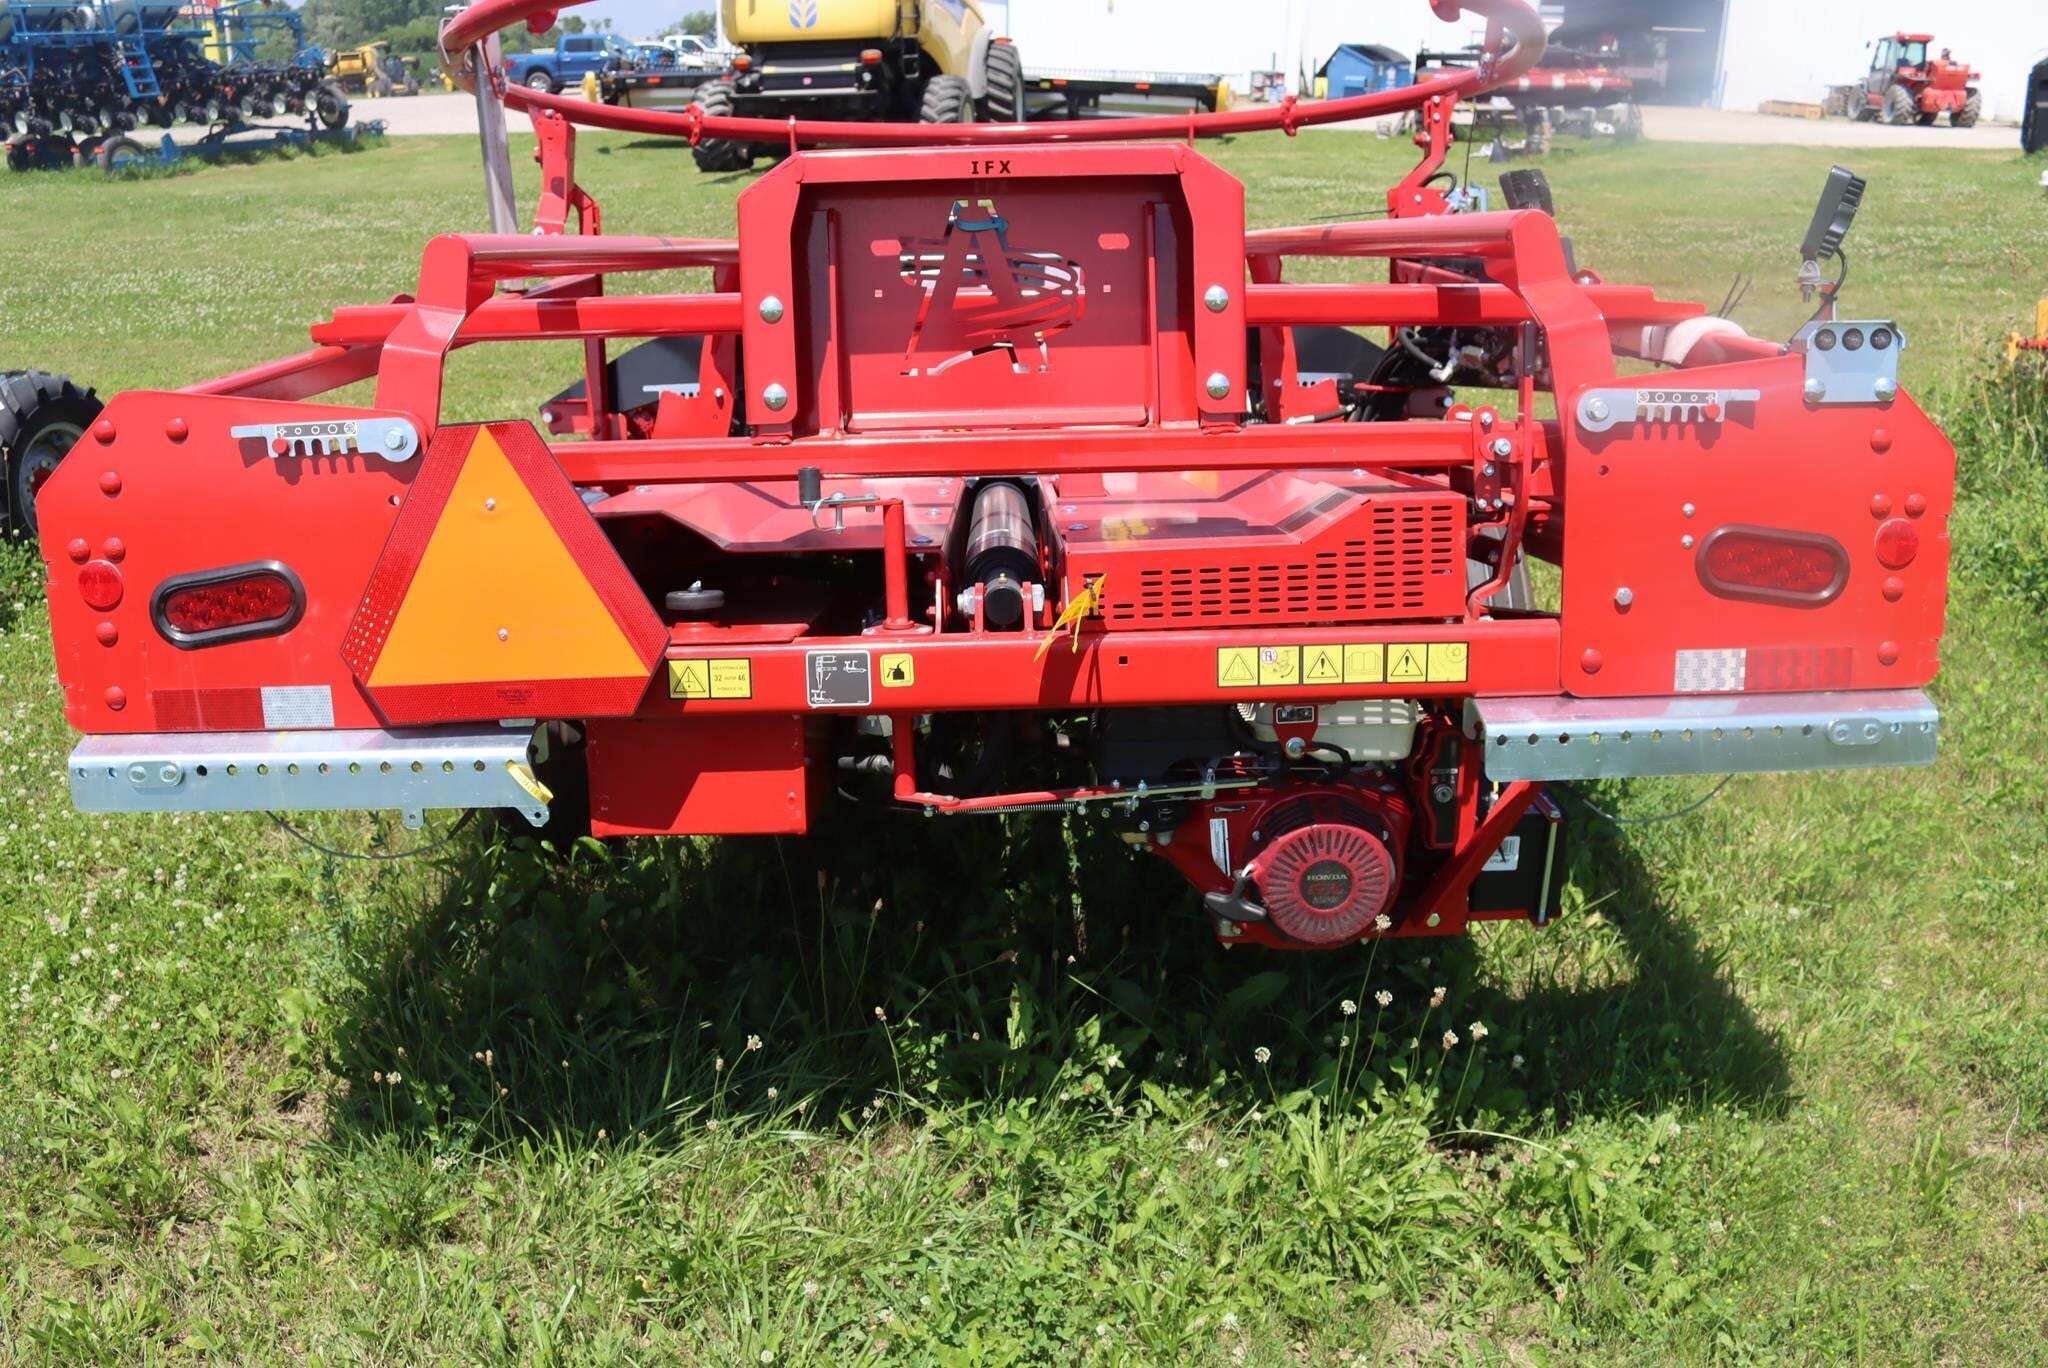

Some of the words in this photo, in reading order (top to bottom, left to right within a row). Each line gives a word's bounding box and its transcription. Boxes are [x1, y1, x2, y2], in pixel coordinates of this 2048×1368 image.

[971, 160, 1011, 175] IFX
[713, 673, 722, 682] 32
[738, 673, 746, 681] 46
[1306, 873, 1348, 881] HONDA
